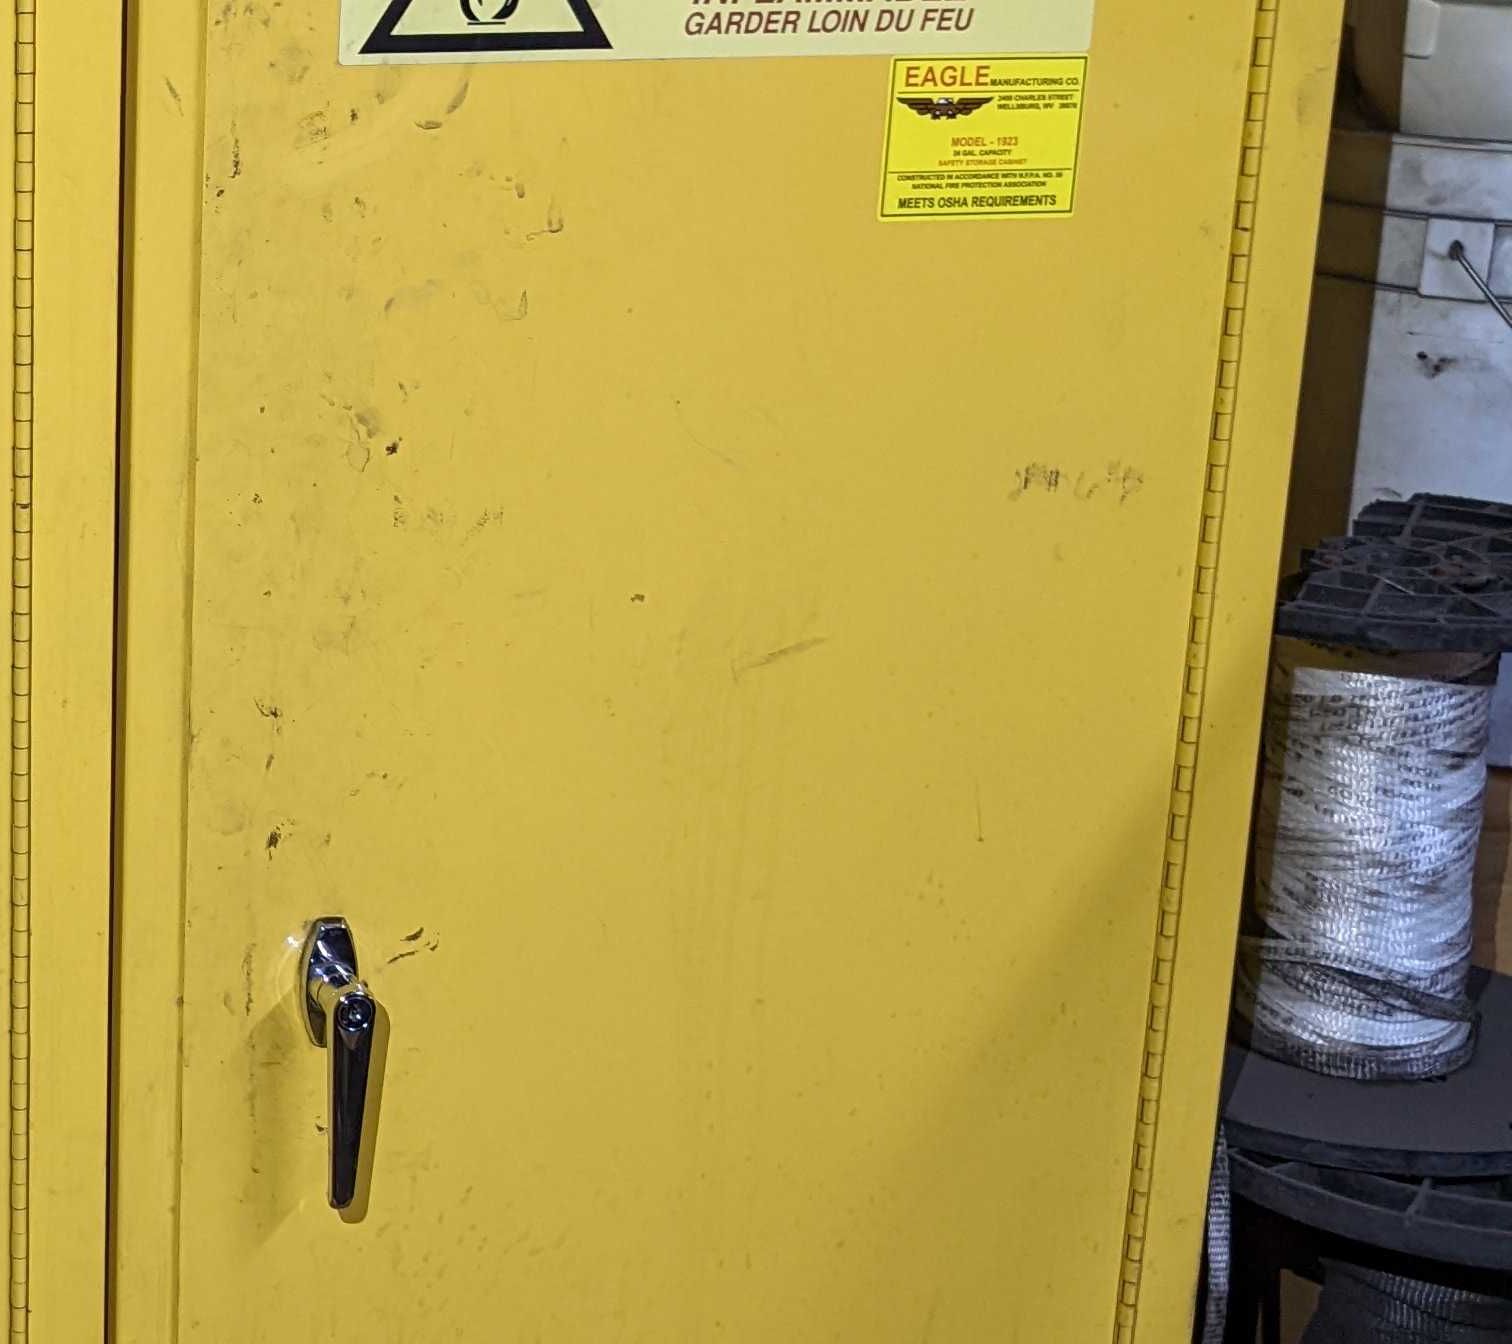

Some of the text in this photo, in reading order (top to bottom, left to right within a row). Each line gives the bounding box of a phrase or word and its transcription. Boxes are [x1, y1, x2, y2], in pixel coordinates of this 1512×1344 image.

[685, 8, 975, 35] GARDER LOIN DU FEU
[905, 65, 991, 87] EAGLE
[990, 77, 1063, 87] MANUFACTURING
[951, 137, 987, 147] MODEL
[898, 194, 1057, 209] MEETS OSHA REQUIREMENTS
